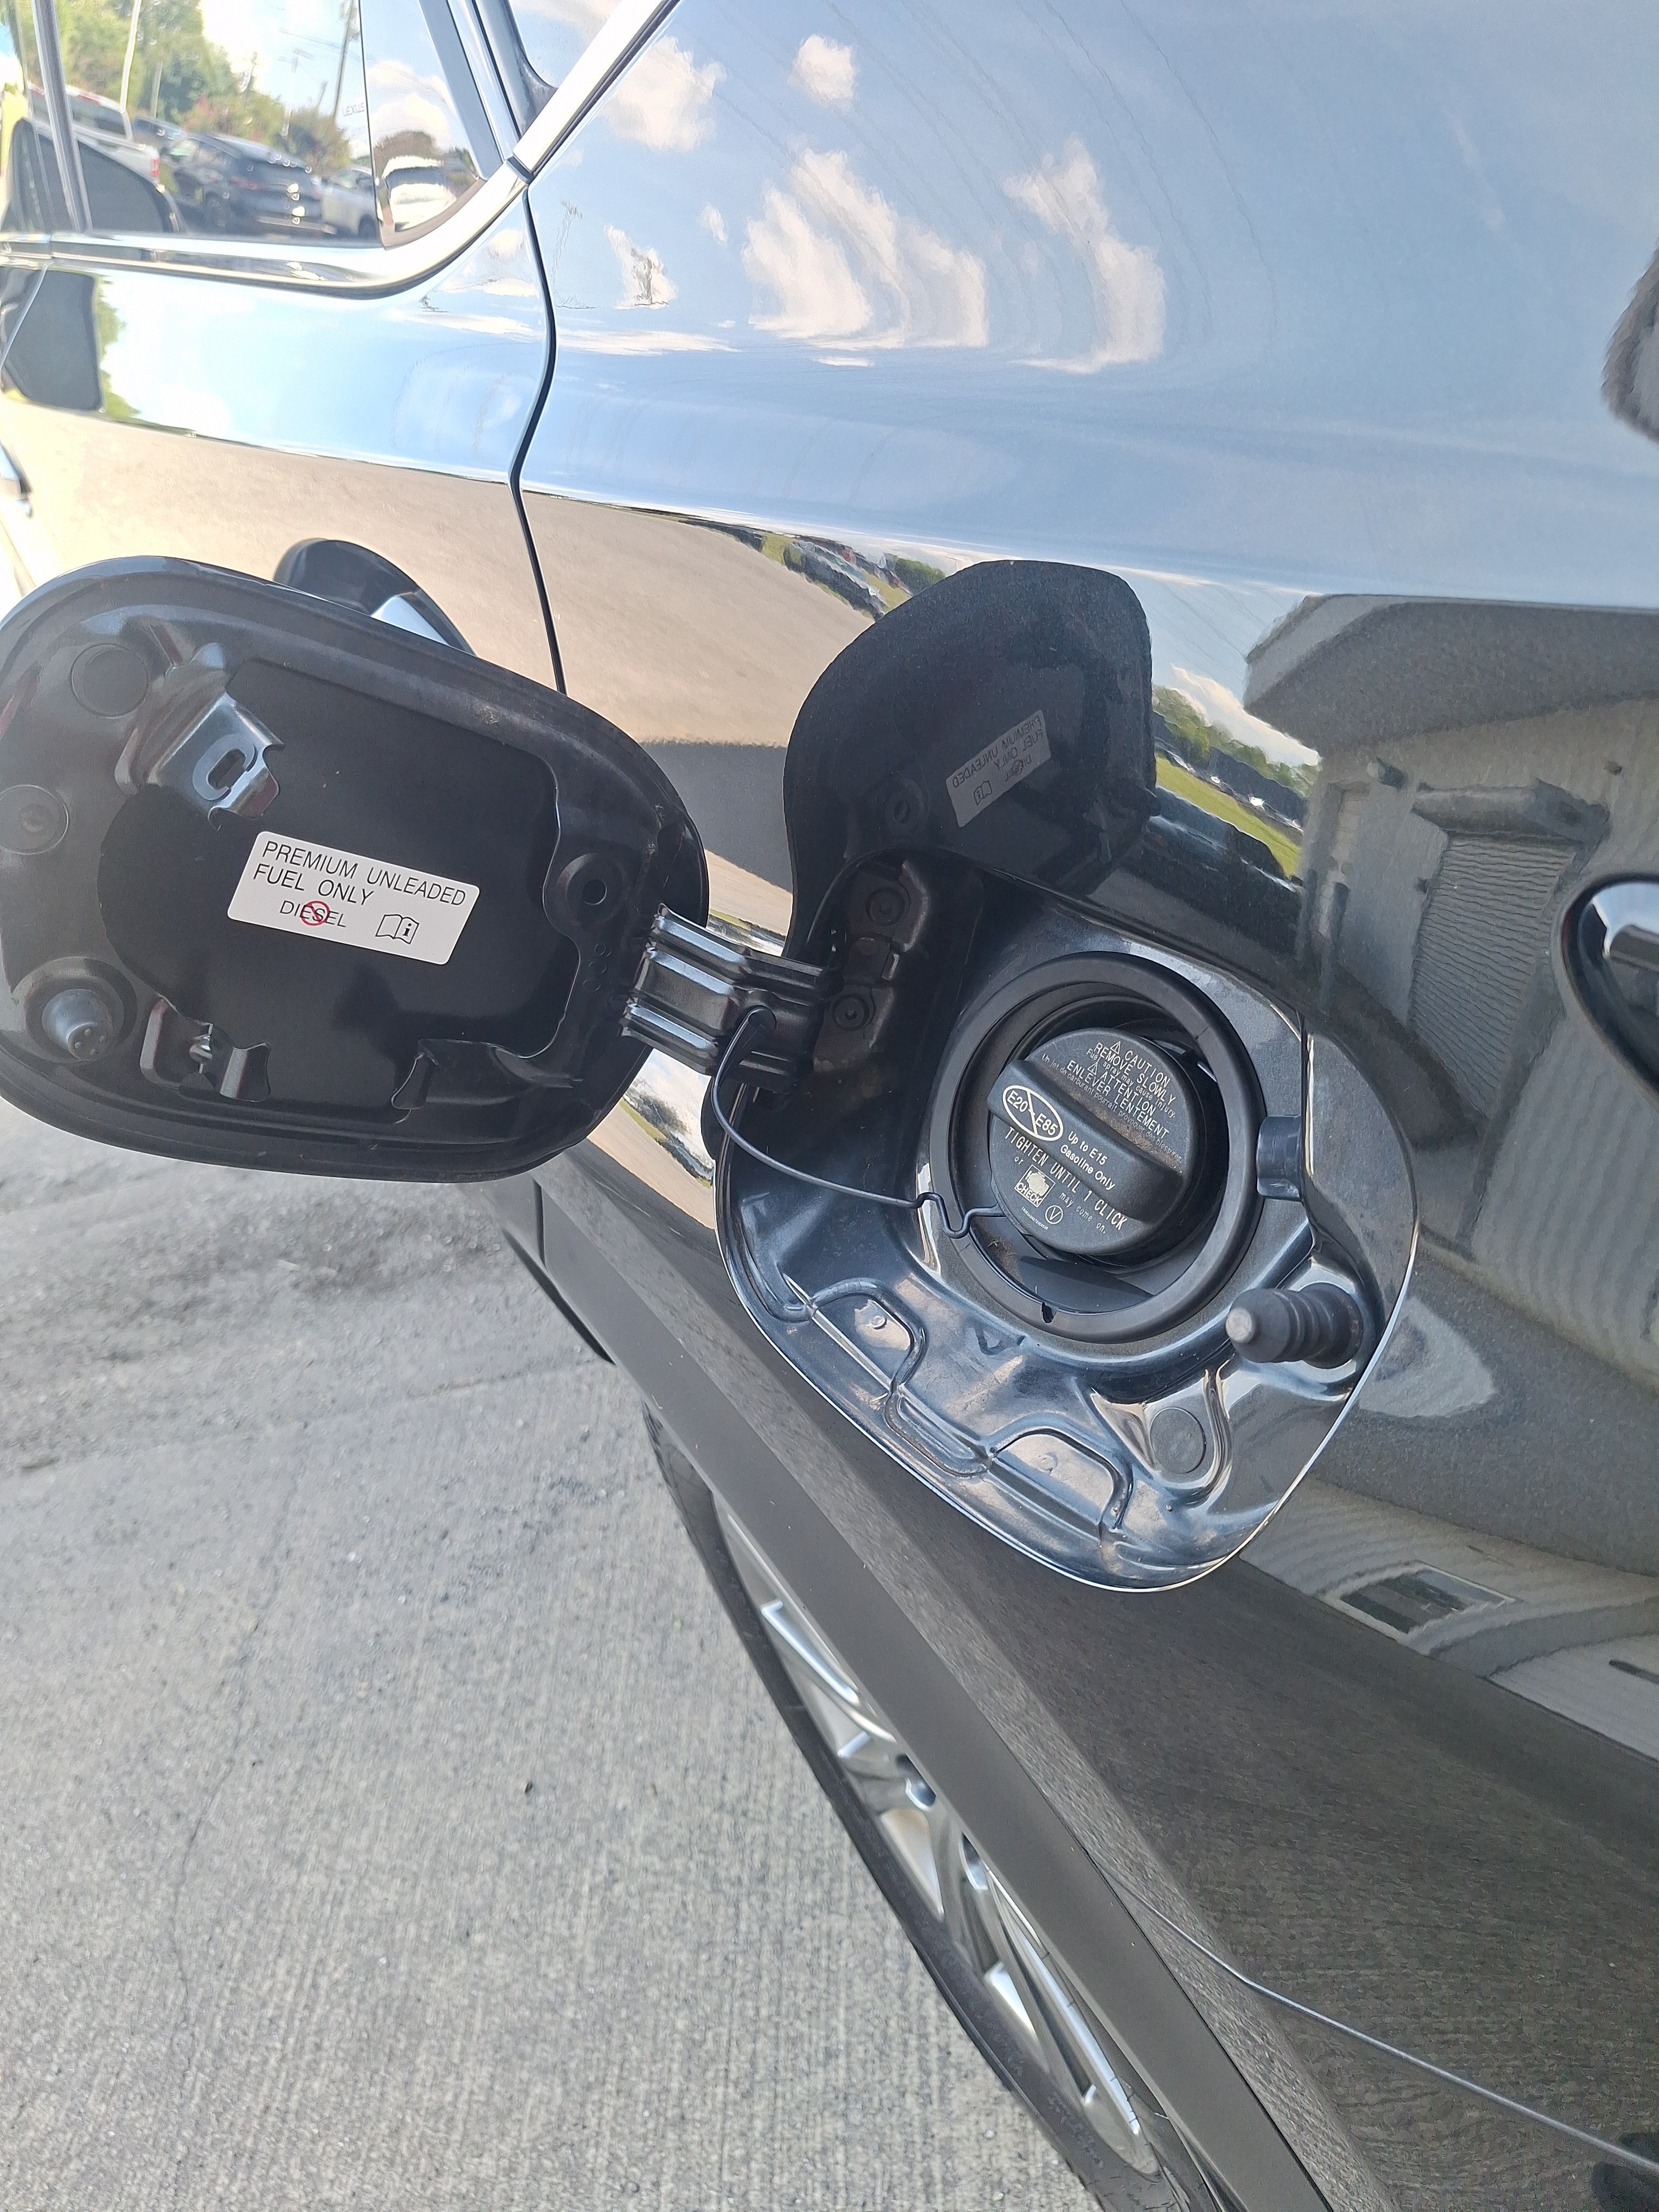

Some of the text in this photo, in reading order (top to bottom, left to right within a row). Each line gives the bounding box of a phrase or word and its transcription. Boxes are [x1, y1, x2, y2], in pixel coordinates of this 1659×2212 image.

[253, 864, 375, 906] FUEL ONLY
[262, 840, 466, 906] PREMIUM UNLEADED
[279, 899, 346, 928] DIESEL
[1041, 1053, 1050, 1063] Un
[1086, 1048, 1101, 1063] Fuel
[1103, 1062, 1121, 1077] spray
[1122, 1075, 1134, 1087] may
[1136, 1085, 1153, 1101] cause
[1094, 1043, 1176, 1105] REMOVE SLOWLY
[1125, 1050, 1171, 1088] CAUTION
[1067, 1060, 1169, 1139] ENLEVER LENTEMENT
[1099, 1071, 1156, 1116] ATTENTION
[1060, 1144, 1116, 1191] Gasoline Only
[1068, 1131, 1108, 1165] Up to E15
[1005, 1127, 1127, 1230] TIGHTEN UNTIL 1 CLICK
[1014, 1156, 1024, 1165] or
[1059, 1192, 1074, 1207] may
[1076, 1206, 1093, 1221] come
[1017, 1182, 1043, 1205] CHECK
